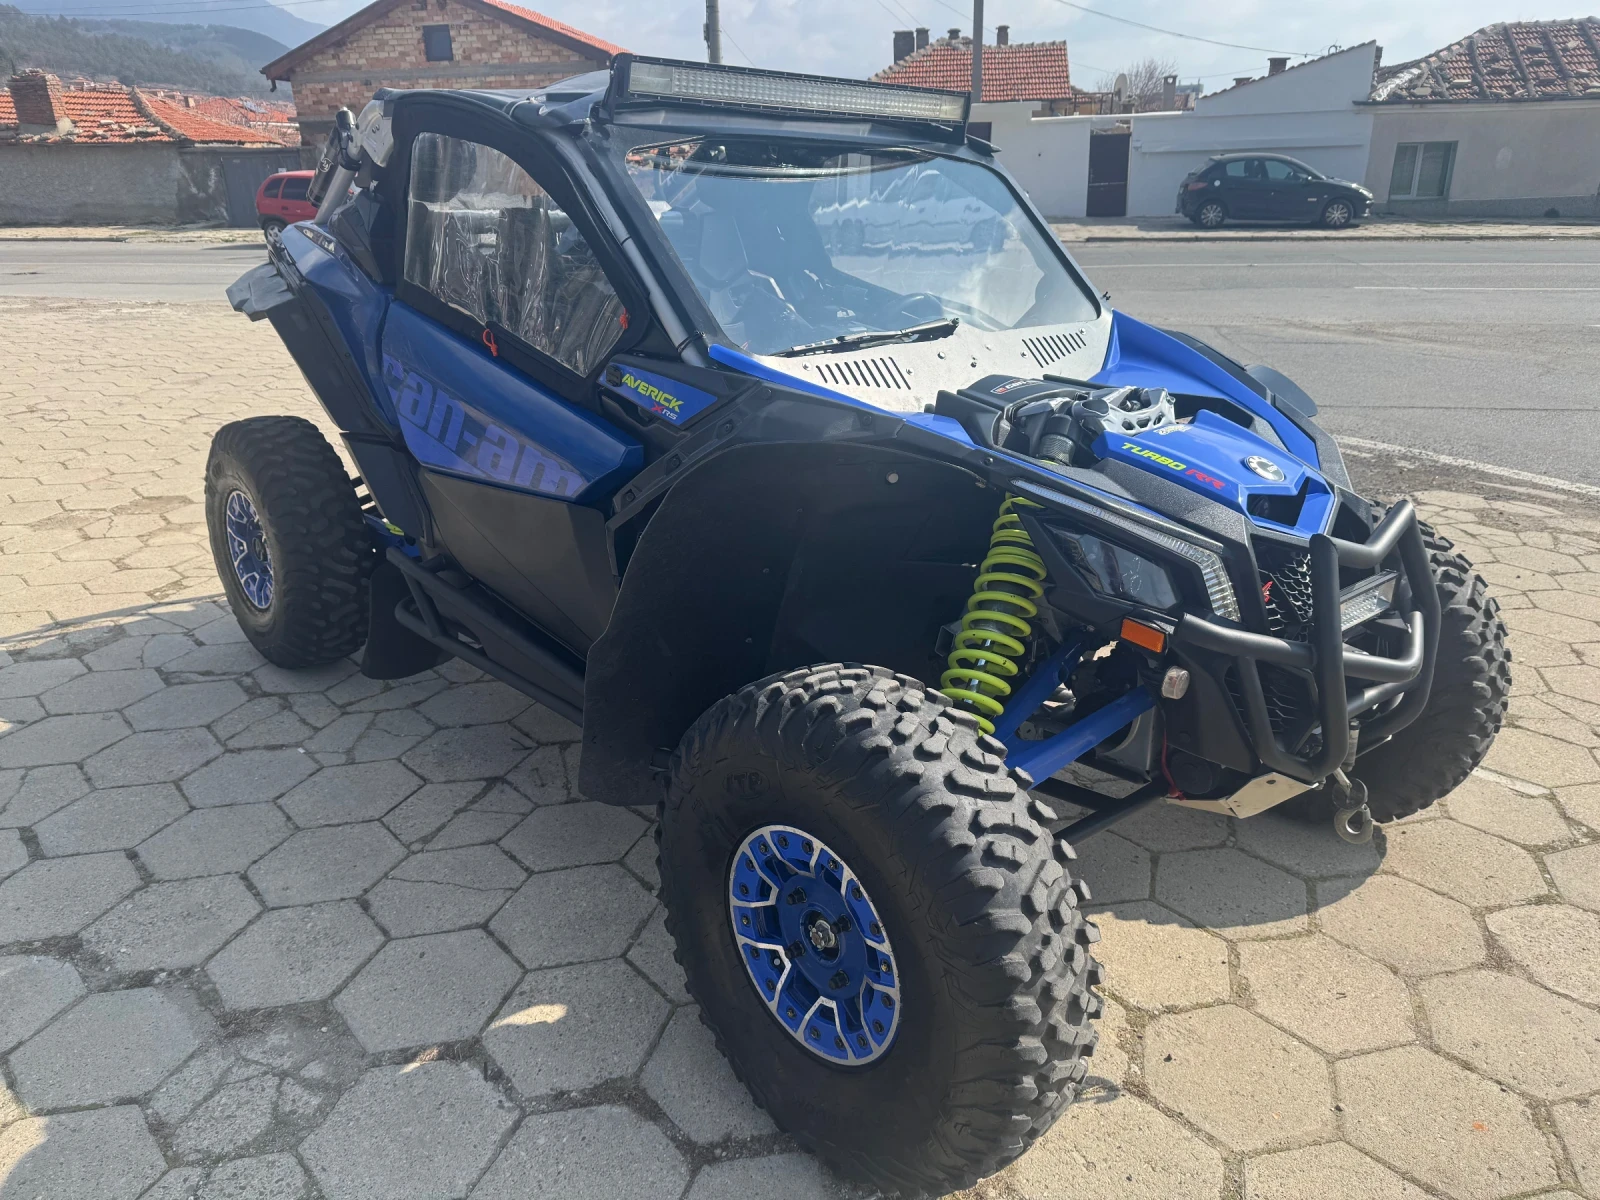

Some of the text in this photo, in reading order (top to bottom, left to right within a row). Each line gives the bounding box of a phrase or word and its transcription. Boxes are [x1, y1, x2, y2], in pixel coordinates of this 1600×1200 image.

[622, 373, 684, 413] AVERICK
[382, 353, 584, 498] can-am
[1121, 442, 1225, 489] TURBO RR
